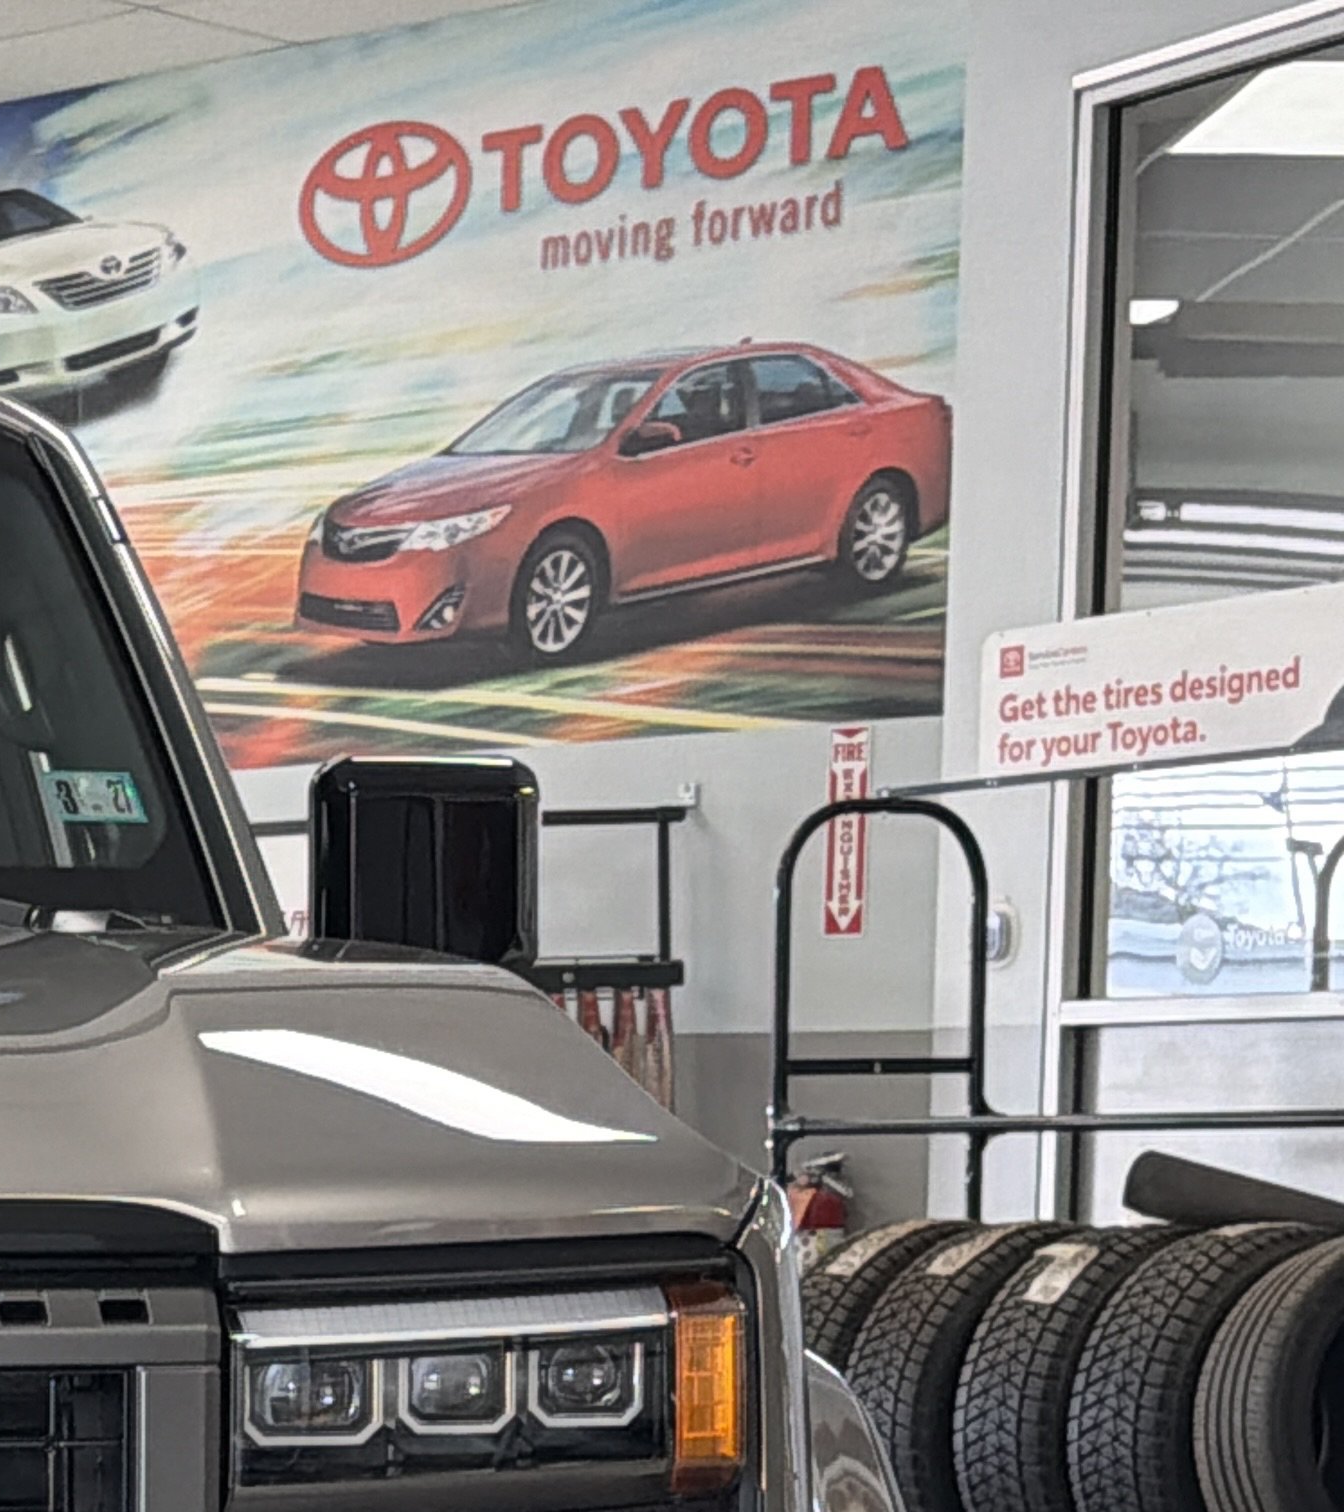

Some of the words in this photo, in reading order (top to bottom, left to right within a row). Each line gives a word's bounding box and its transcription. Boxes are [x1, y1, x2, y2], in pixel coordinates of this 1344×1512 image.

[482, 66, 909, 212] TOYOTA
[541, 215, 676, 270] moving
[692, 182, 844, 246] forward
[999, 692, 1048, 723] Get
[1053, 684, 1098, 716] the
[1102, 678, 1164, 711] tires
[1169, 656, 1302, 705] designed
[834, 743, 865, 763] FIRE
[997, 731, 1037, 764] for
[1041, 729, 1104, 767] your
[1108, 717, 1208, 757] Toyota.
